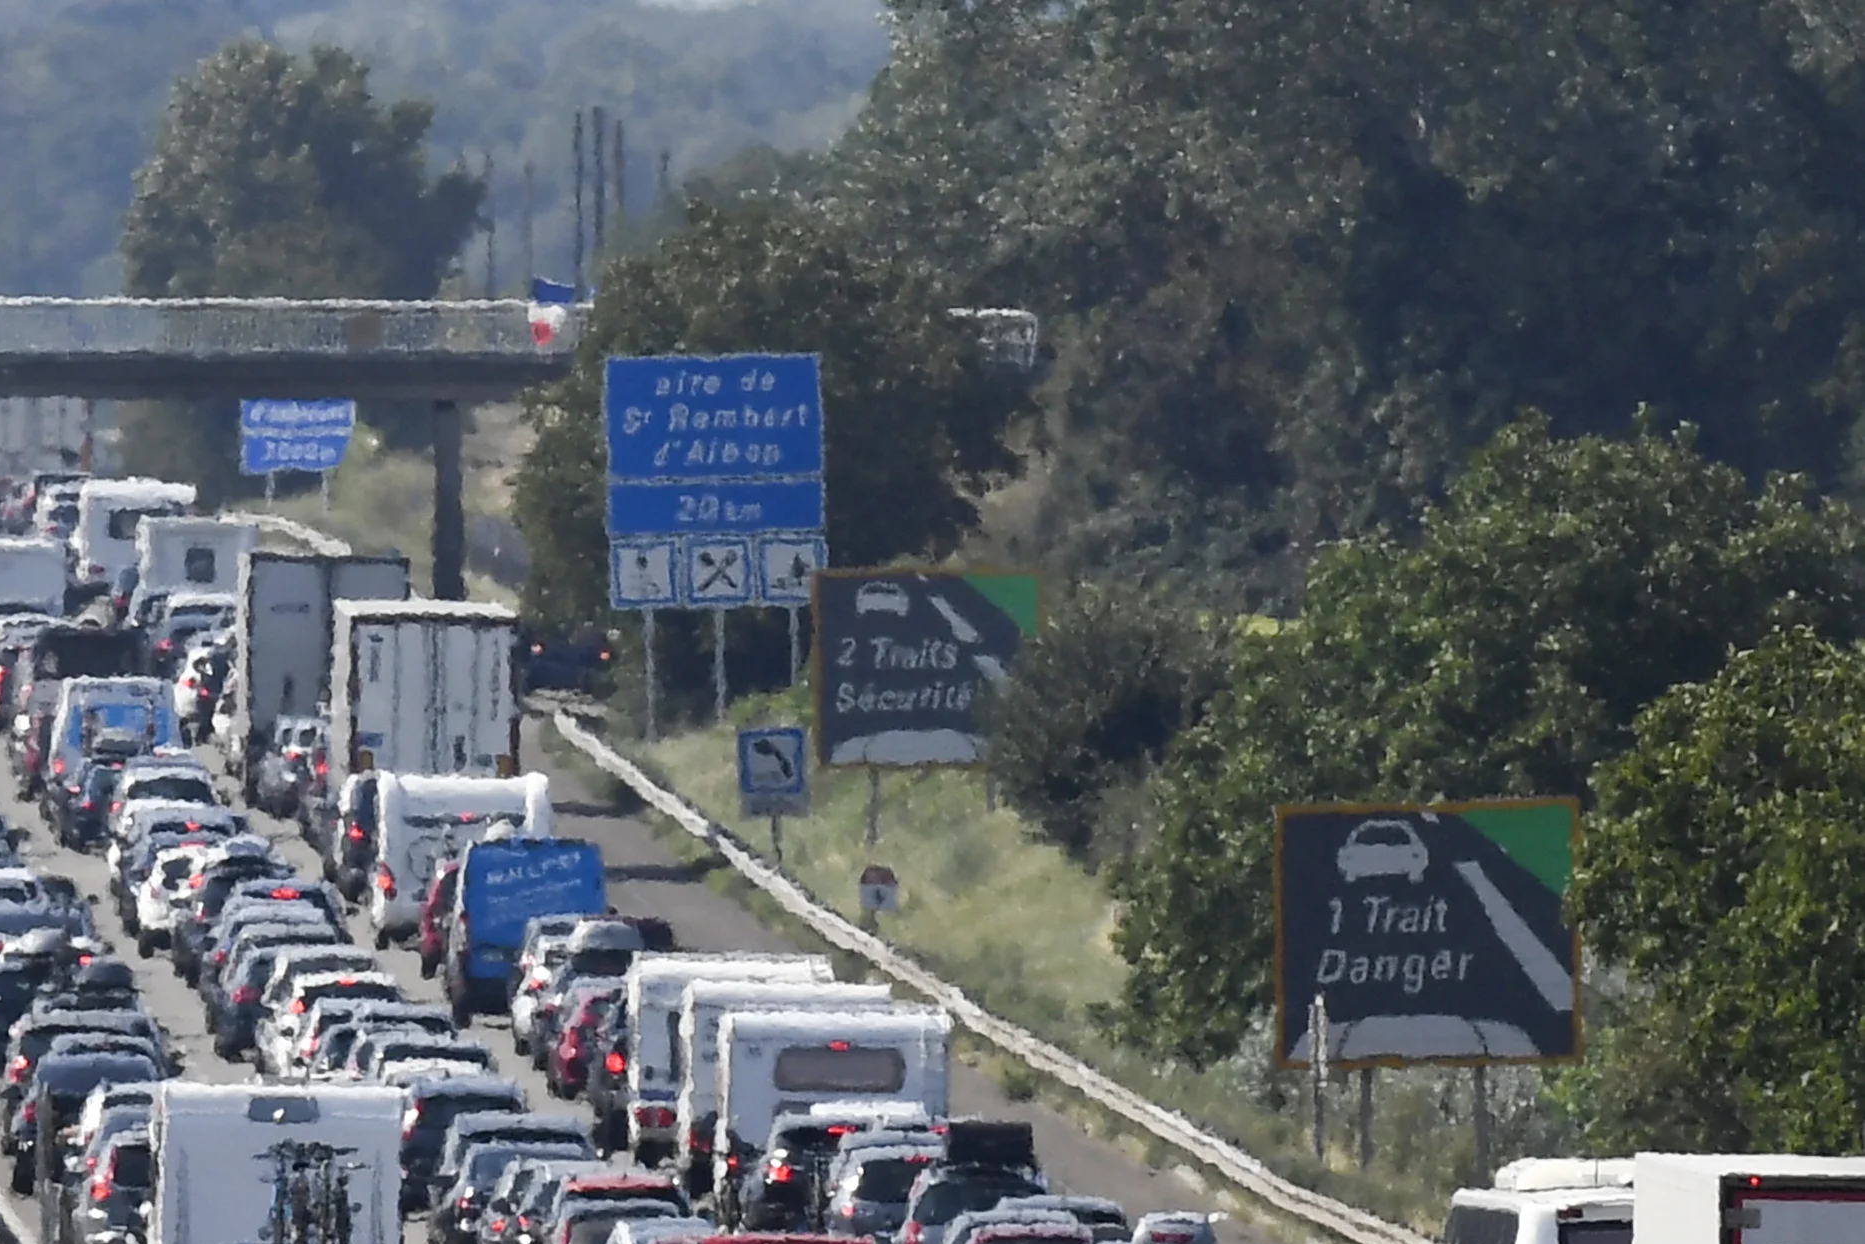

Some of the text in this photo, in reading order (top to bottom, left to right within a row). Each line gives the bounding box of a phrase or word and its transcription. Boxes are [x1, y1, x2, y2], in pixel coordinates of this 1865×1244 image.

[740, 368, 775, 391] de
[837, 636, 958, 669] 2 Traits
[835, 679, 974, 713] Sécurité
[1328, 896, 1448, 934] 1 Trait
[1316, 949, 1475, 994] Danger
